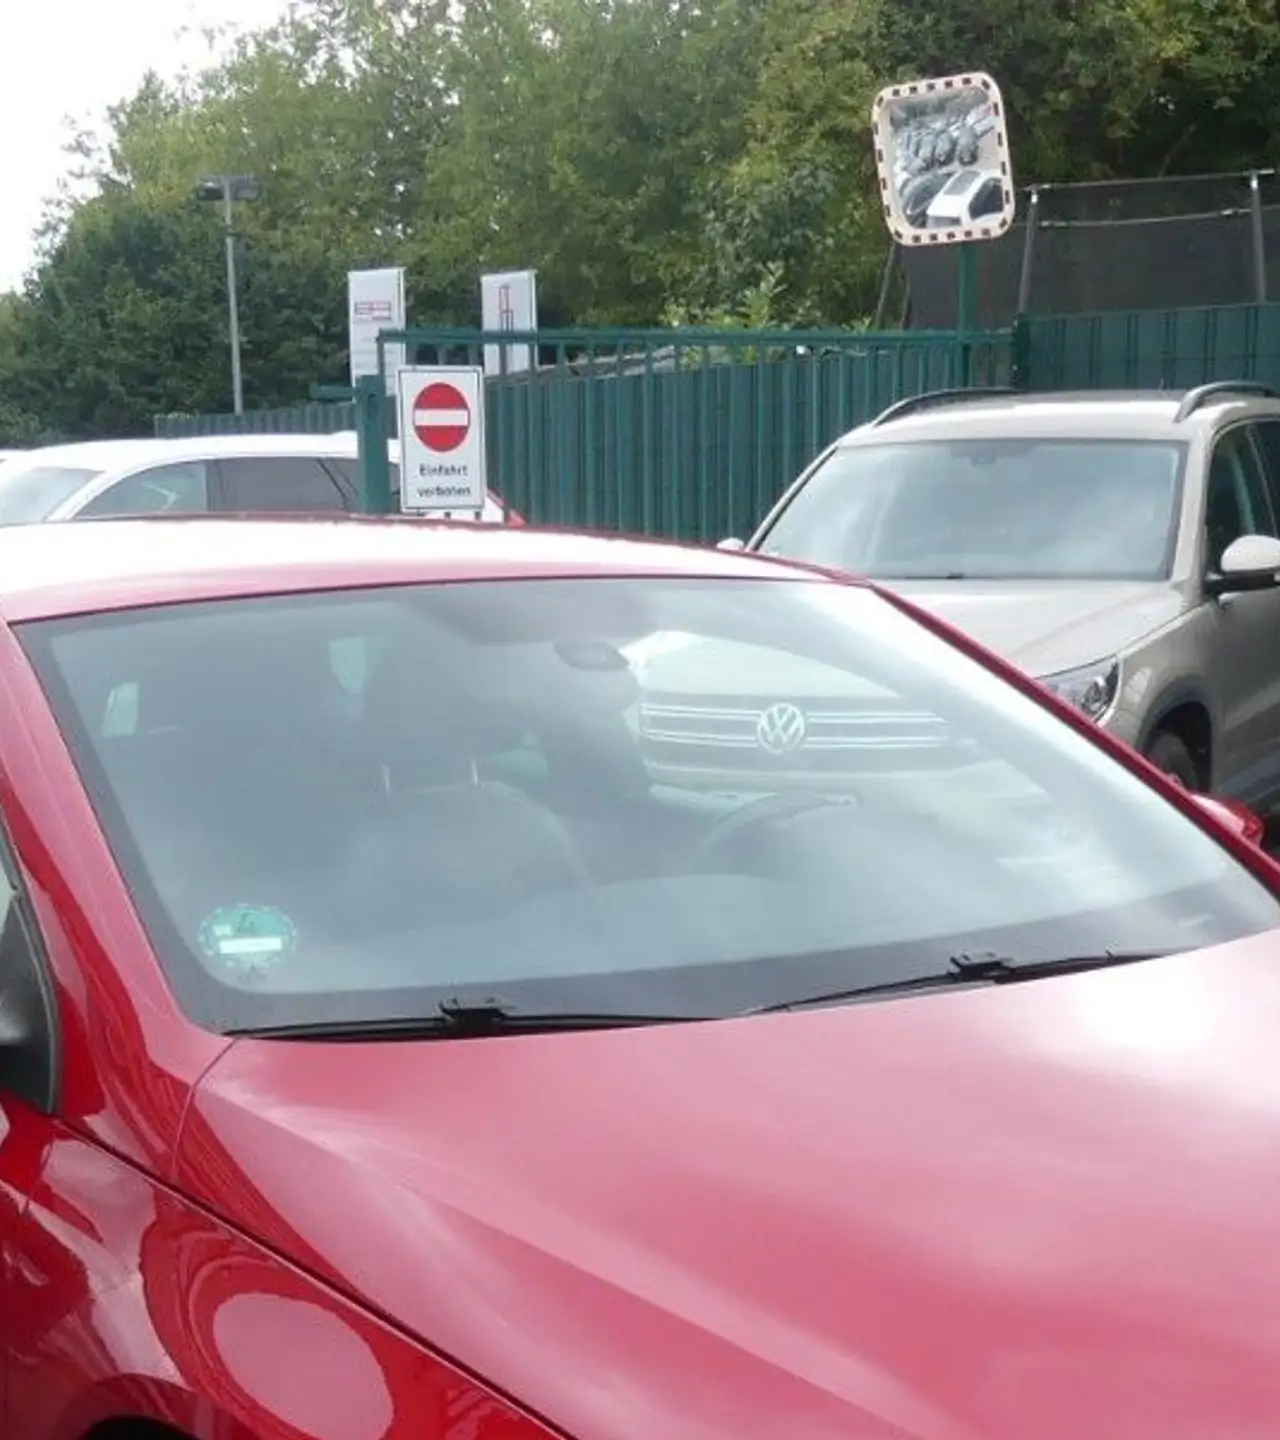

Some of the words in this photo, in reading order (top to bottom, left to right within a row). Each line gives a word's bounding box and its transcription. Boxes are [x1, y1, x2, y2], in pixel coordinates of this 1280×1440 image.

[419, 463, 468, 476] Einfahrt
[417, 485, 471, 498] verboten
[756, 702, 805, 754] VW
